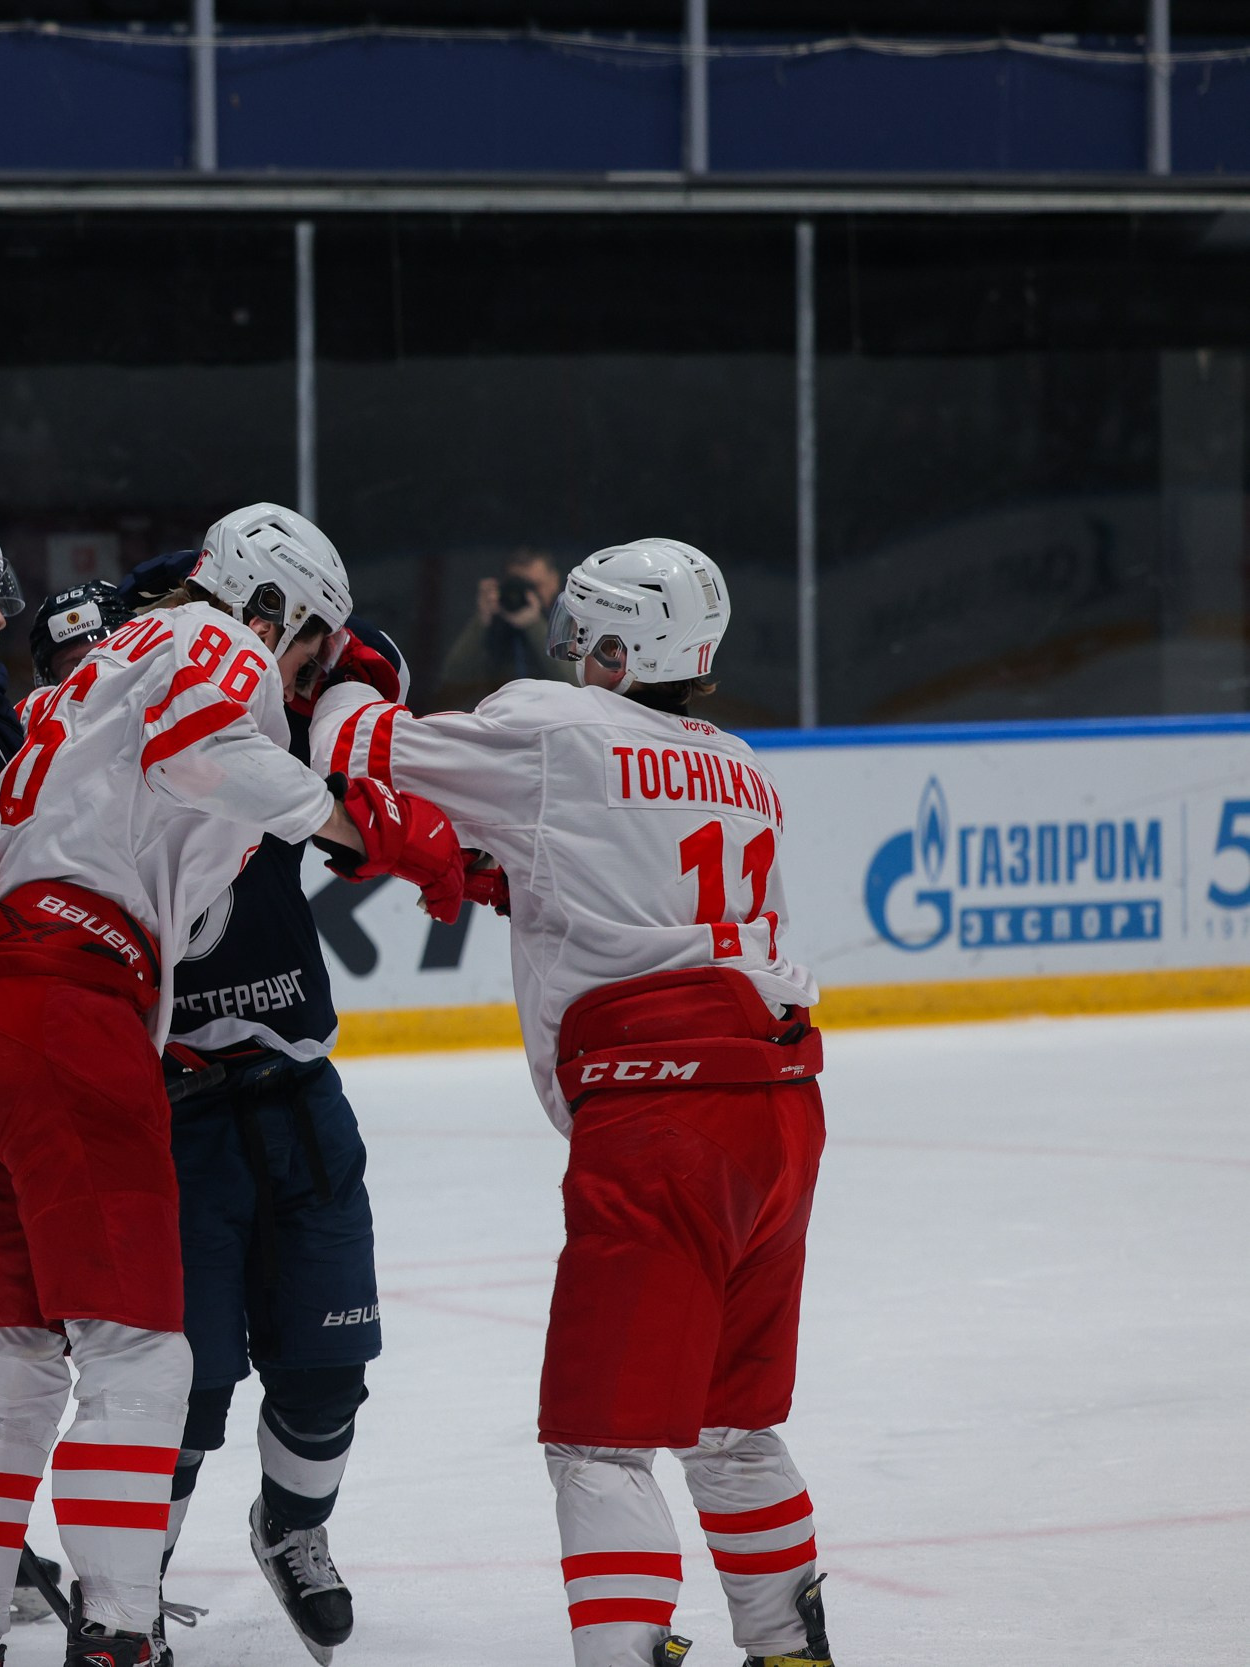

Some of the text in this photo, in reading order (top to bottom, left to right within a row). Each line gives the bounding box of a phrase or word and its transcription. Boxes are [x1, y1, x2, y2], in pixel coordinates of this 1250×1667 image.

[278, 553, 315, 579] BAUER
[595, 598, 633, 614] BAUER
[58, 620, 95, 638] OLIMPBET
[188, 624, 268, 703] 86
[697, 641, 713, 675] 11
[612, 747, 772, 820] TOCHILKIN
[679, 820, 776, 925] 11
[958, 819, 1161, 888] ГАЗПРОМ
[36, 895, 142, 965] BAUER
[962, 904, 1157, 944] ЭКСПОРТ
[580, 1061, 701, 1084] CCM
